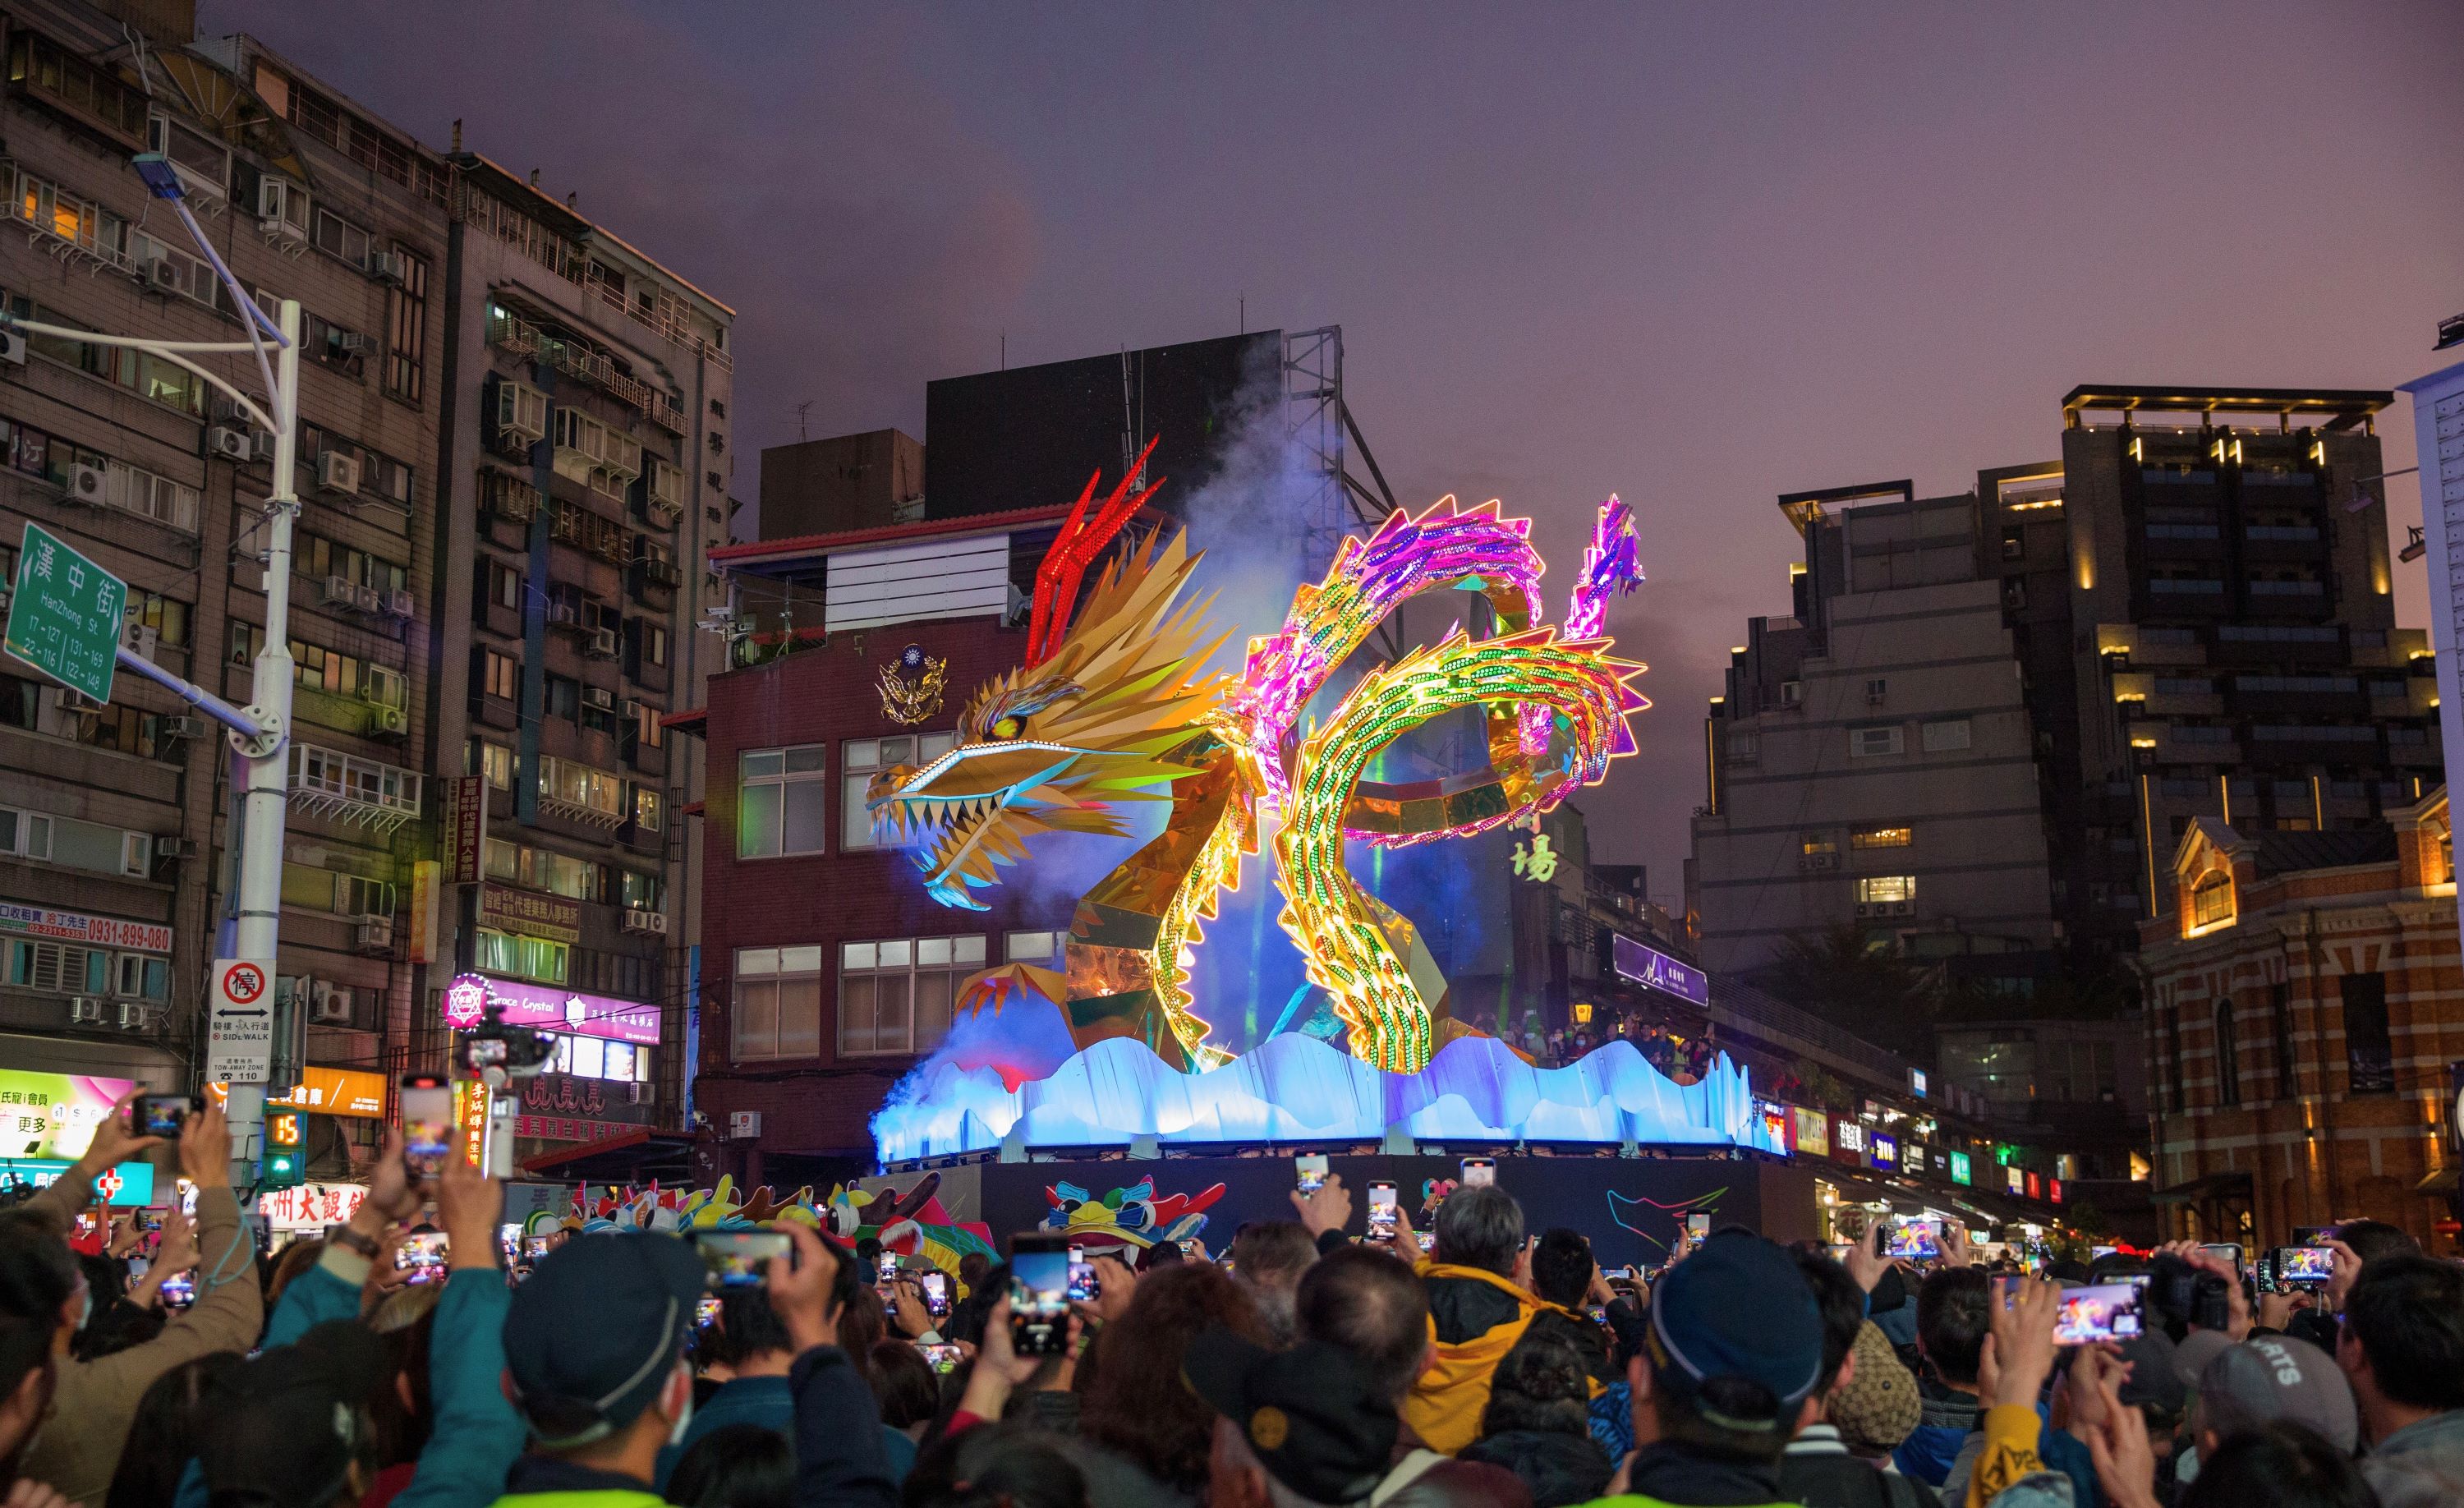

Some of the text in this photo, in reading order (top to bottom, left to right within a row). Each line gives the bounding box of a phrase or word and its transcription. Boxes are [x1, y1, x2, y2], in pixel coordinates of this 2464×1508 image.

[34, 539, 117, 618] 漢中街
[41, 590, 99, 636] HanZhong St
[89, 918, 169, 950] 0931-899-080
[232, 972, 256, 995] 停
[493, 995, 554, 1013] race Crystal
[238, 1072, 257, 1080] 110
[0, 1091, 48, 1106] 氏寵i會員
[18, 1116, 46, 1133] 更多
[277, 1115, 299, 1143] 15
